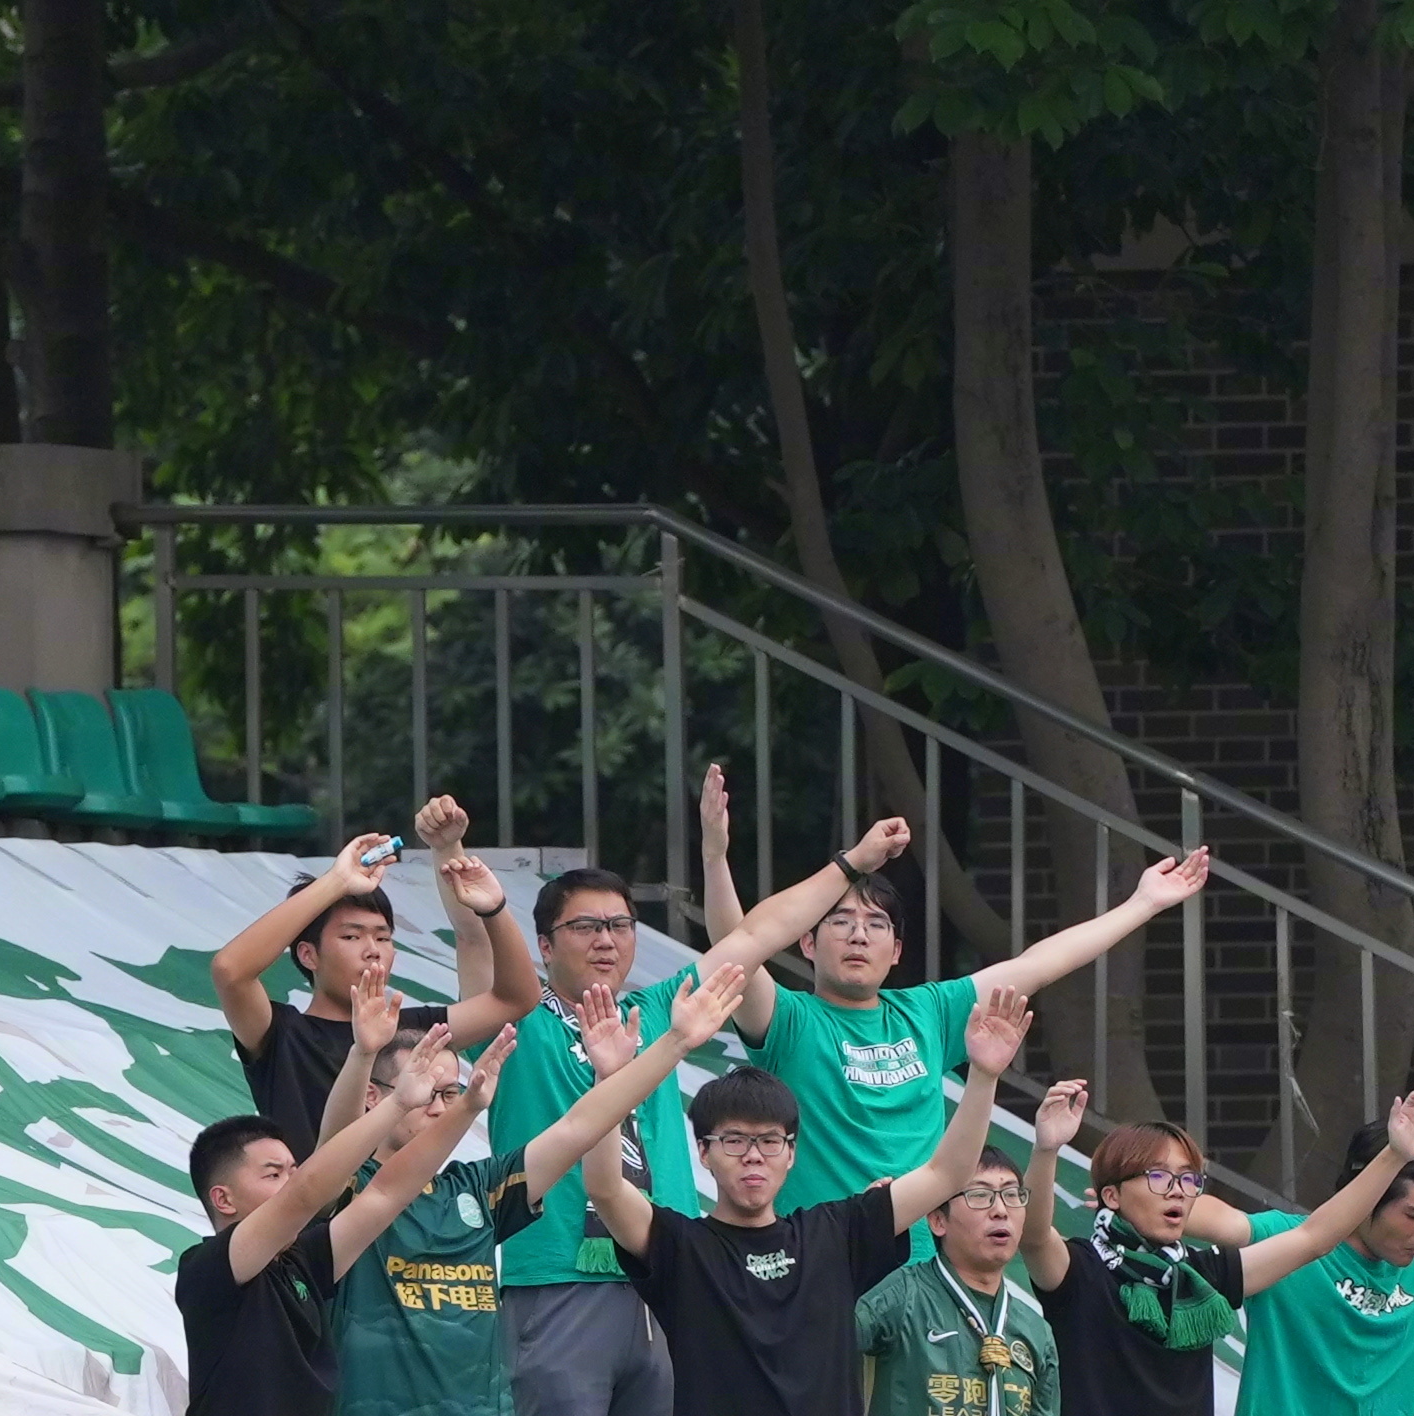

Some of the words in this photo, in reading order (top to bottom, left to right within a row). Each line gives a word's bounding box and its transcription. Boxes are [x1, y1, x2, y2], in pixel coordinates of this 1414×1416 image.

[387, 1256, 494, 1281] Panasonc
[394, 1282, 497, 1311] 松下电器
[927, 1373, 987, 1406] 零跑
